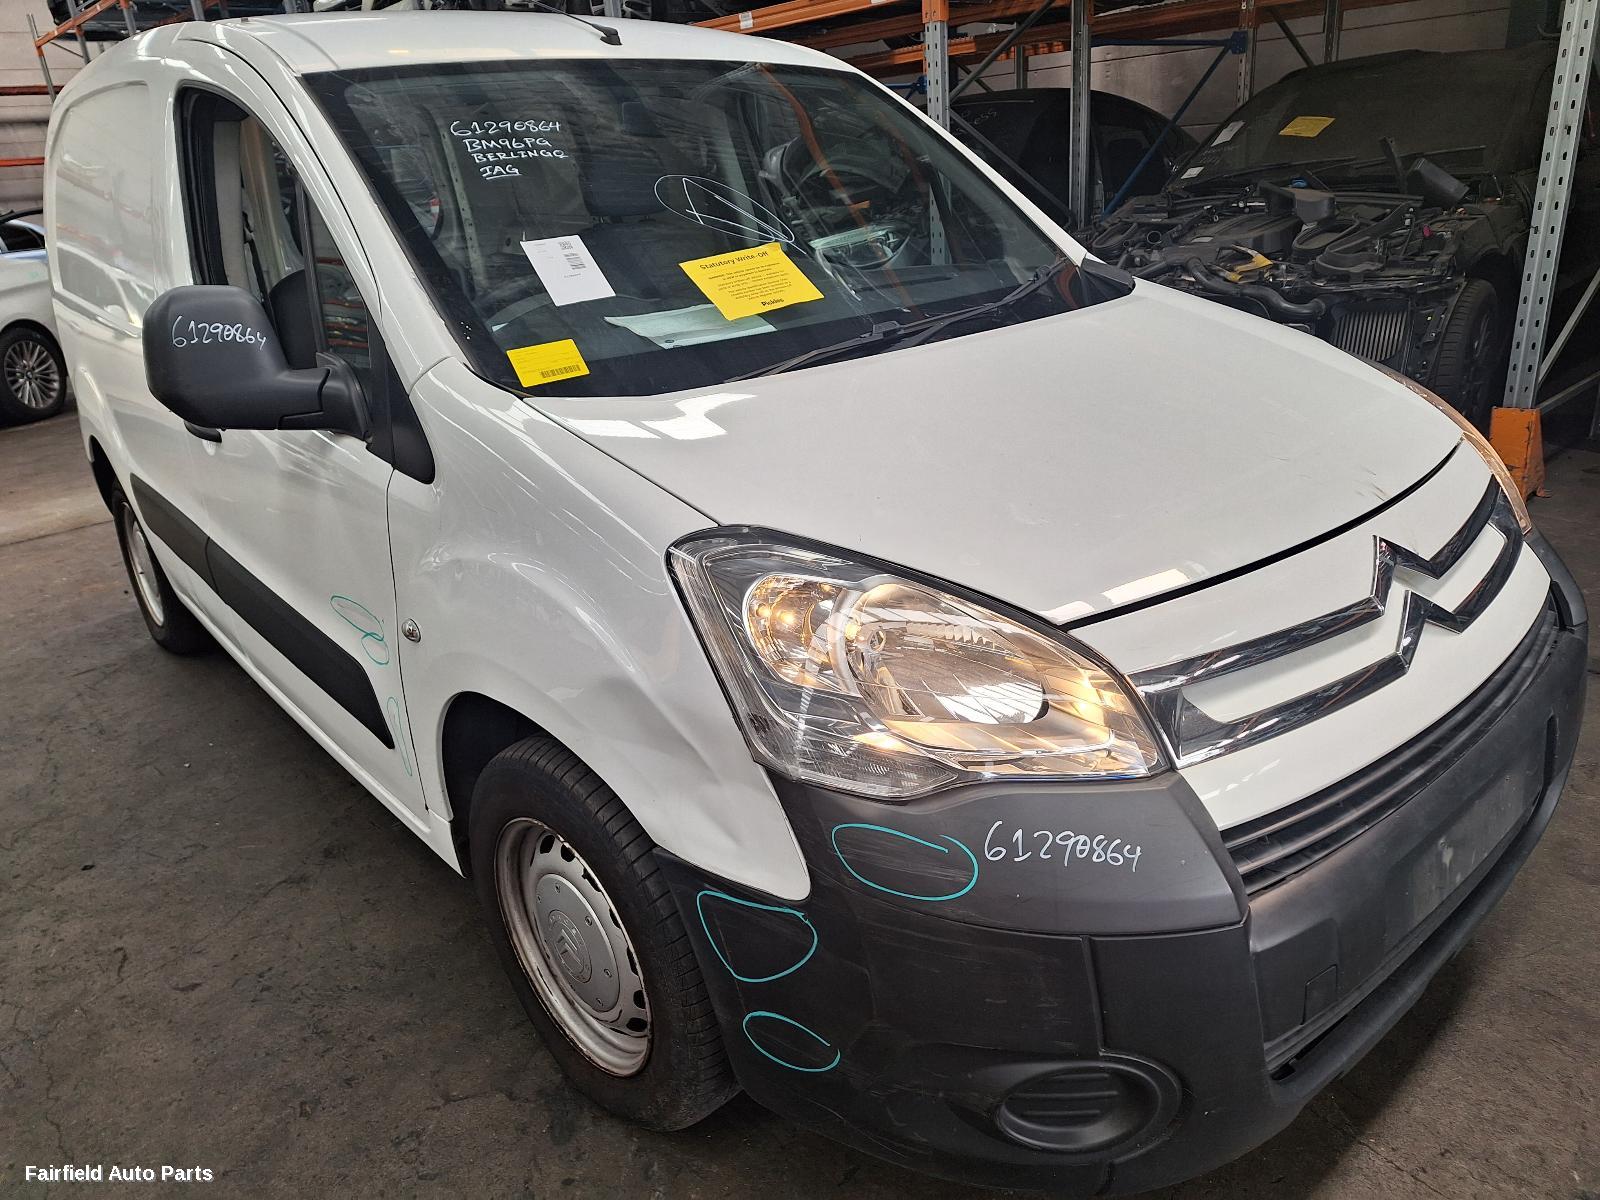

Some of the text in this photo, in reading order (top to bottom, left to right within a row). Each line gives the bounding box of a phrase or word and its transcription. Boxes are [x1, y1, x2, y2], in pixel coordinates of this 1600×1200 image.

[450, 120, 560, 136] 61290864
[700, 250, 768, 270] Statutory Write-Off
[172, 315, 267, 351] 61290864
[984, 820, 1142, 873] 61290864
